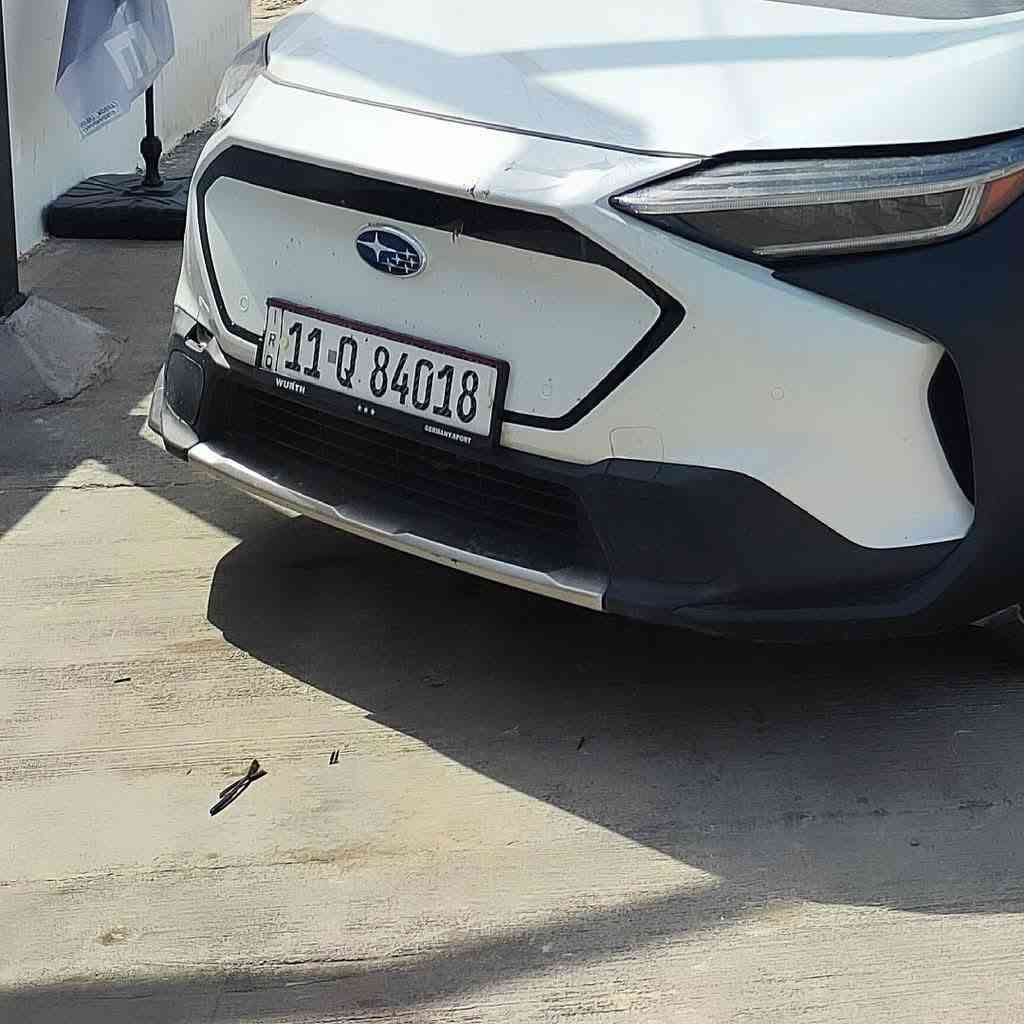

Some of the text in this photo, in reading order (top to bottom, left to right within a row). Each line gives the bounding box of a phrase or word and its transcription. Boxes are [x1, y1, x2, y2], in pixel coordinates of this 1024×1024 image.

[285, 322, 480, 424] 11 Q 84018
